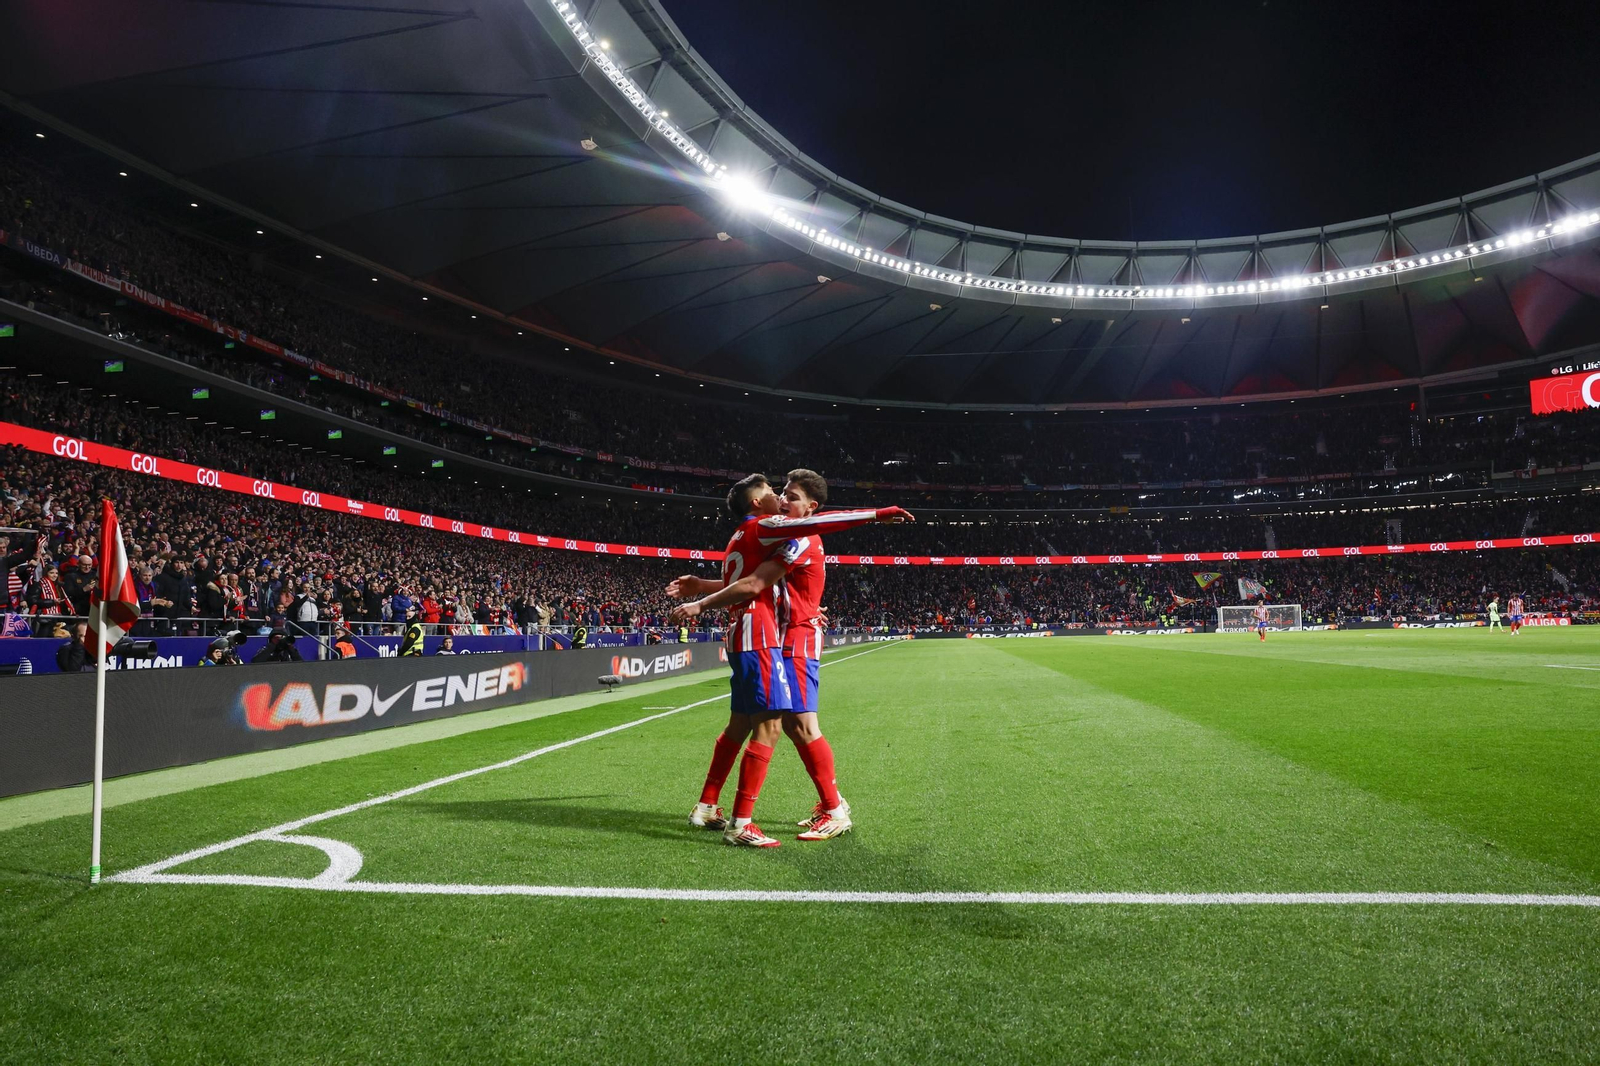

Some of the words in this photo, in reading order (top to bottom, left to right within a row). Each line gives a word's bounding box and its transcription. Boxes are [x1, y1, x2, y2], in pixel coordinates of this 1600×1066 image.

[1559, 365, 1573, 374] LG
[53, 436, 88, 460] GOL
[131, 453, 161, 476] GOL
[197, 468, 222, 488] GOL
[253, 480, 275, 498] GOL
[302, 490, 322, 508] GOL
[384, 507, 401, 521] GOL
[420, 514, 434, 529] GOL
[452, 520, 466, 534] GOL
[481, 526, 494, 539] GOL
[508, 531, 521, 543] GOL
[565, 540, 578, 551] GOL
[595, 543, 609, 554] GOL
[626, 546, 640, 556] GOL
[658, 548, 672, 558] GOL
[690, 550, 704, 560] GOL
[825, 555, 840, 564] GOL
[860, 556, 875, 565] GOL
[894, 557, 909, 565] GOL
[964, 557, 980, 565] GOL
[1000, 557, 1015, 565] GOL
[1036, 556, 1051, 564] GOL
[1072, 556, 1088, 564] GOL
[1109, 555, 1125, 563] GOL
[1184, 553, 1201, 561] GOL
[1222, 552, 1239, 560] GOL
[1262, 551, 1279, 559] GOL
[1302, 549, 1320, 557] GOL
[1343, 547, 1362, 555] GOL
[1430, 542, 1449, 551] GOL
[1476, 540, 1496, 549] GOL
[1523, 537, 1544, 546] GOL
[1573, 534, 1595, 543] GOL
[1522, 618, 1557, 626] LALIGA
